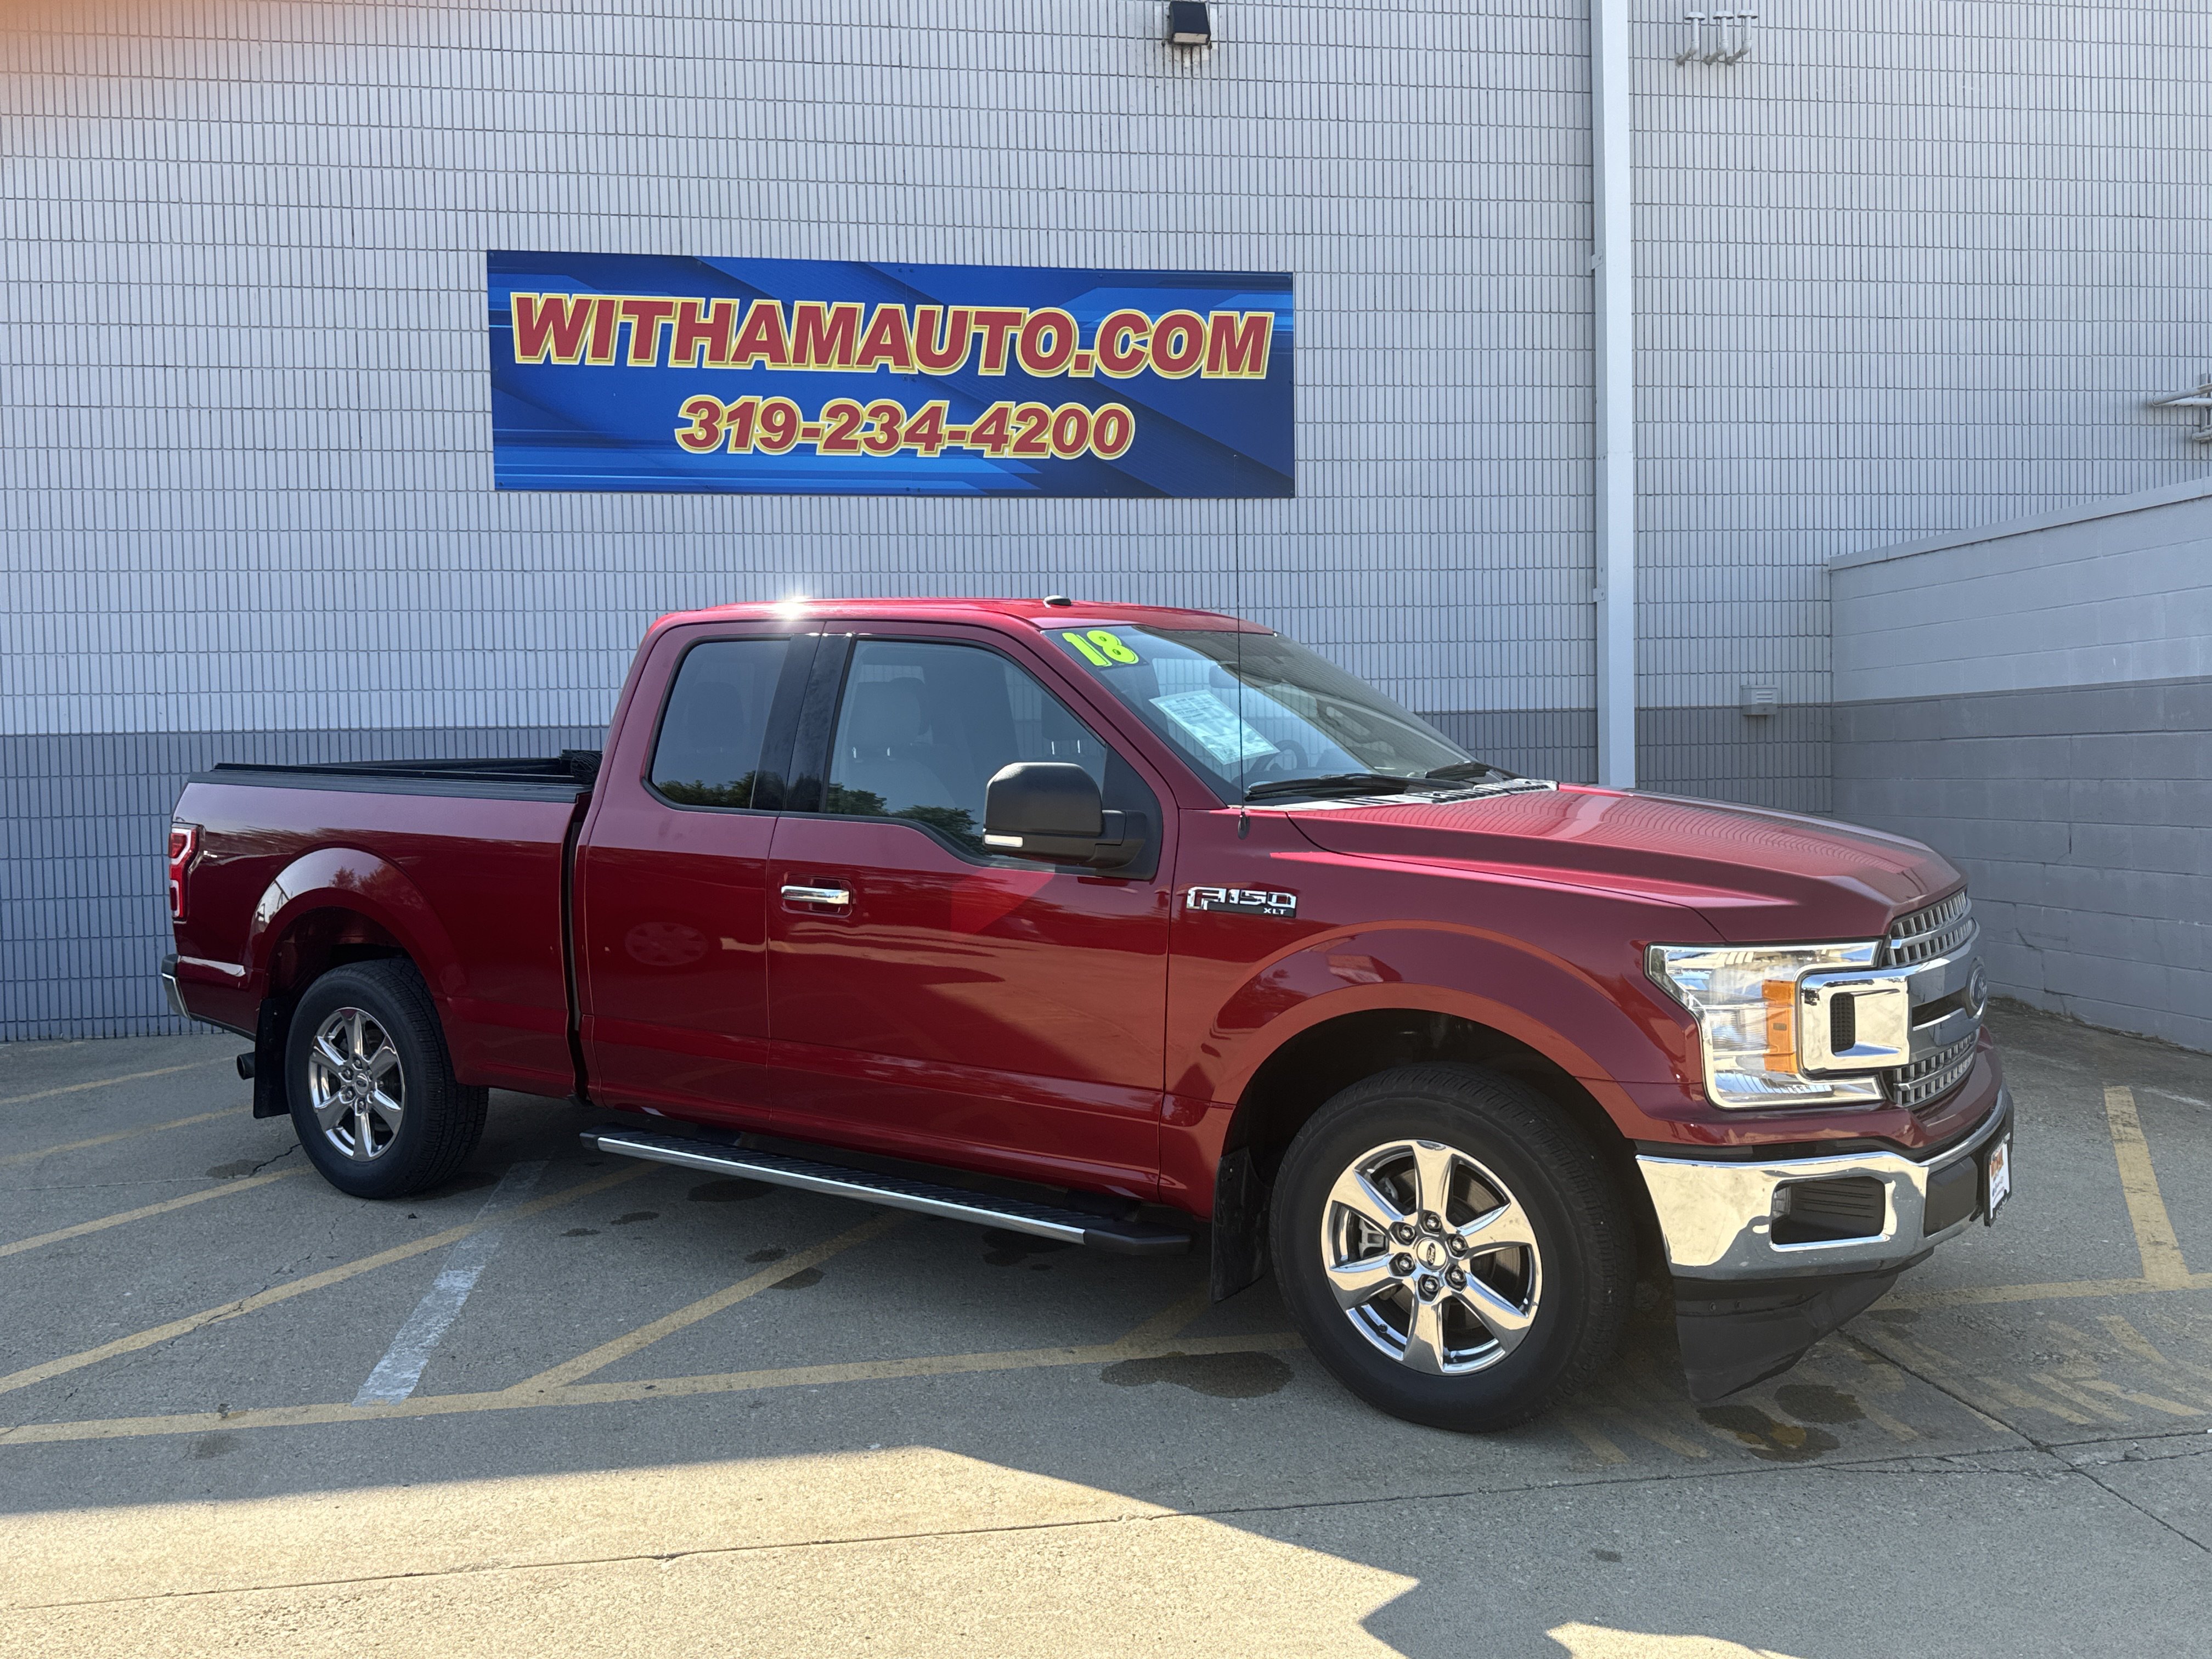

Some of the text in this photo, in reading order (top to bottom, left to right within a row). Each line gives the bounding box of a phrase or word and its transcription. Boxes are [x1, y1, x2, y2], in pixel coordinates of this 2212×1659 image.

[511, 292, 1274, 379] WITHAMAUTO.COM
[674, 395, 1135, 459] 319-234-4200
[1062, 630, 1139, 667] 18
